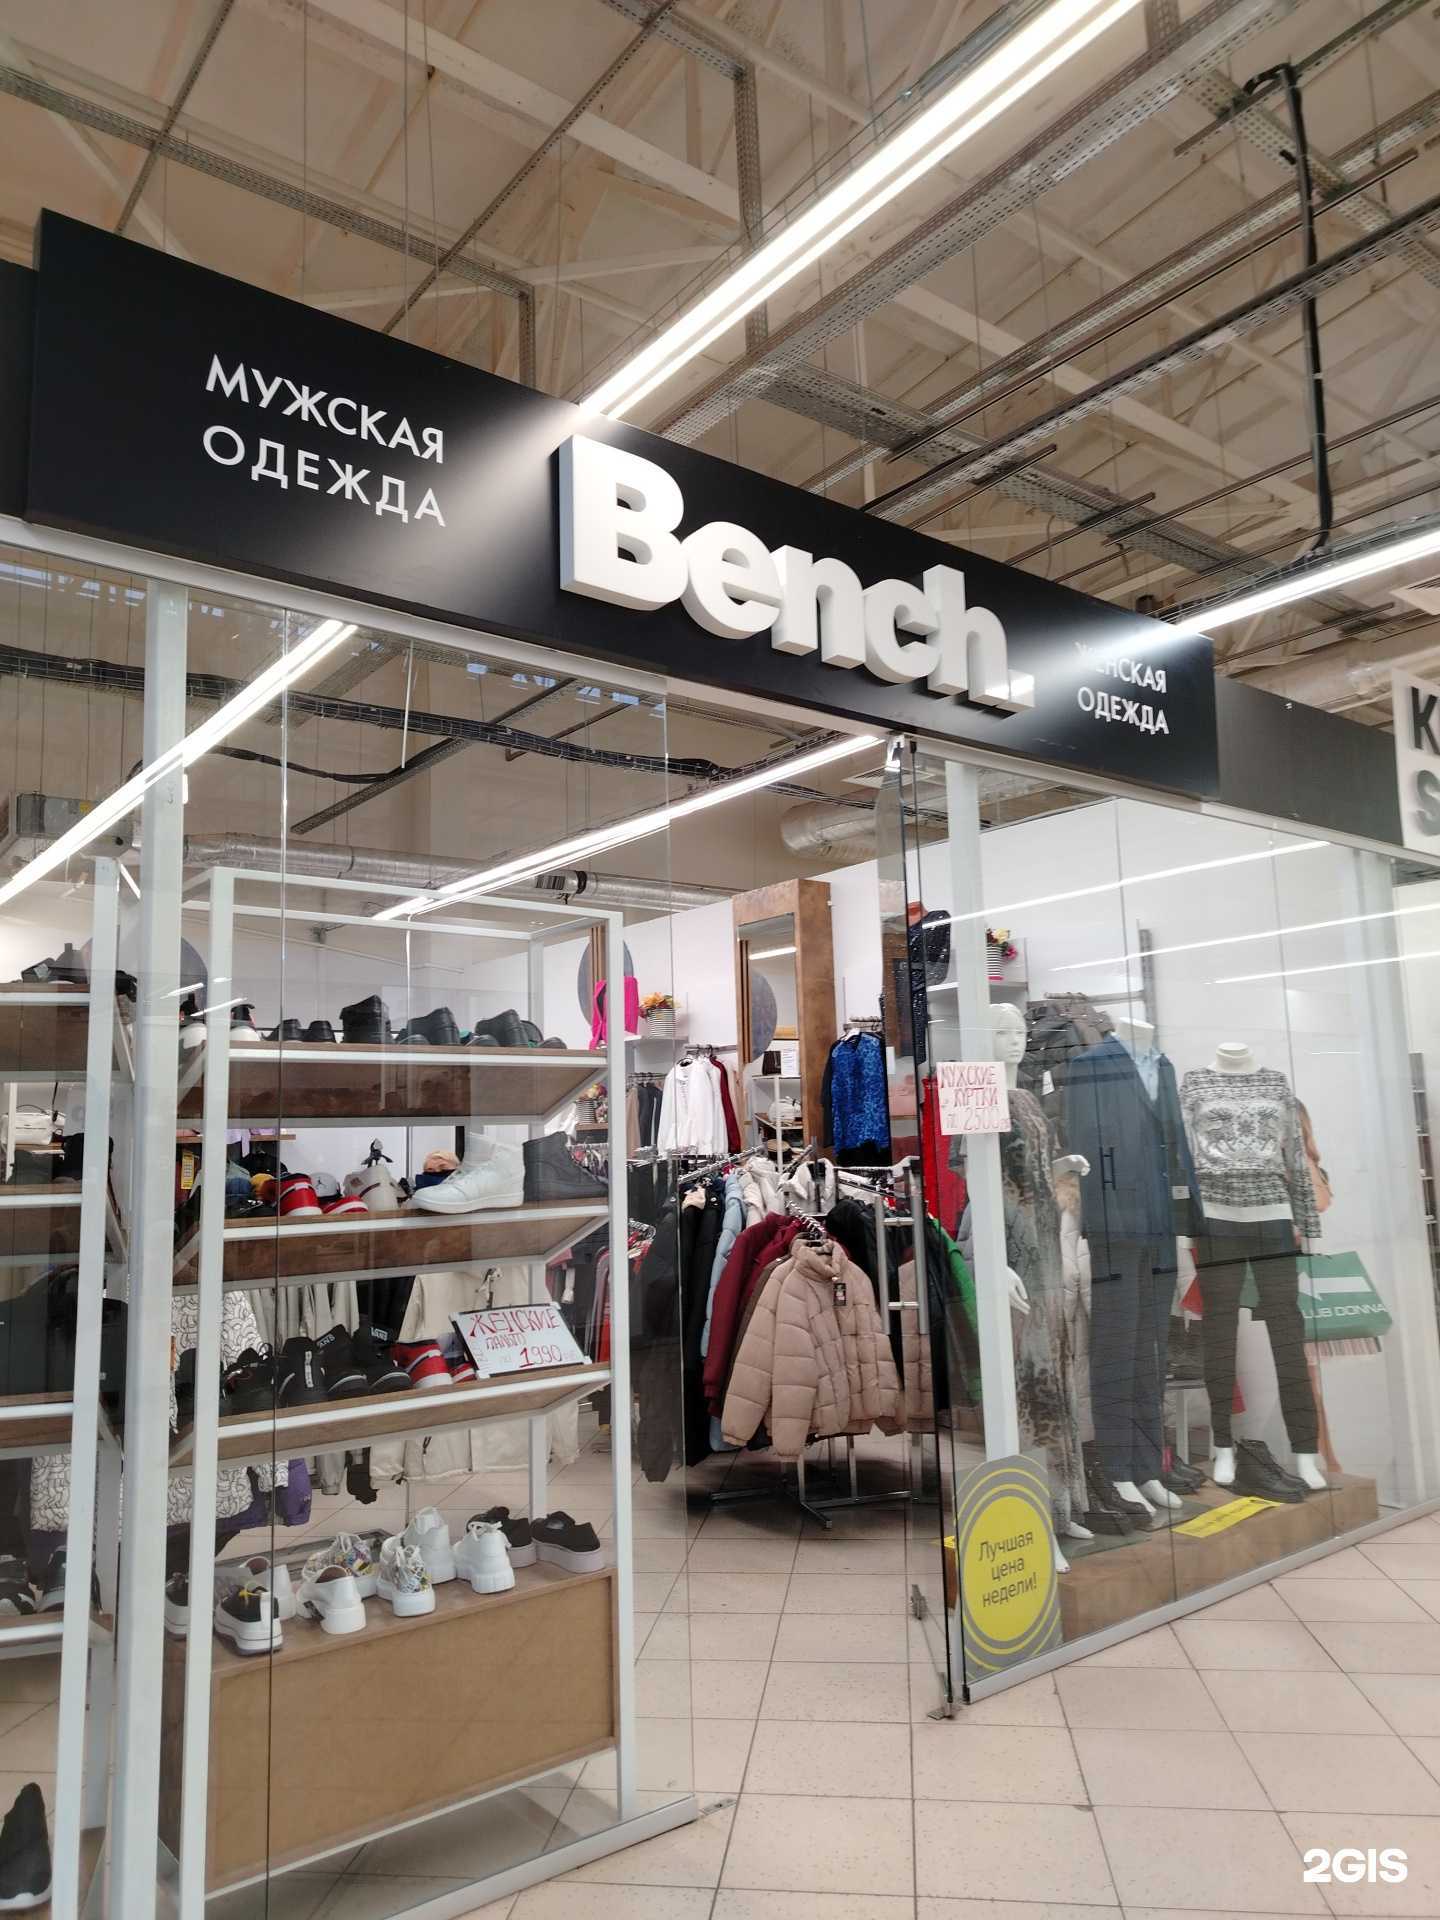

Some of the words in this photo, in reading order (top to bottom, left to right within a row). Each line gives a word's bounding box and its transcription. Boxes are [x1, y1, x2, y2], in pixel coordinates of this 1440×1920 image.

[205, 353, 443, 464] МУЖСКАЯ
[202, 425, 446, 527] ОДЕЖДА
[1074, 641, 1168, 694] НСКАЯ
[1077, 686, 1170, 735] ОДЕЖДА
[469, 1309, 560, 1337] ЖЕНСКИЕ
[519, 1343, 562, 1369] 1990
[979, 1531, 1034, 1562] Лучшая
[991, 1557, 1025, 1582] цена
[982, 1571, 1038, 1608] недели!
